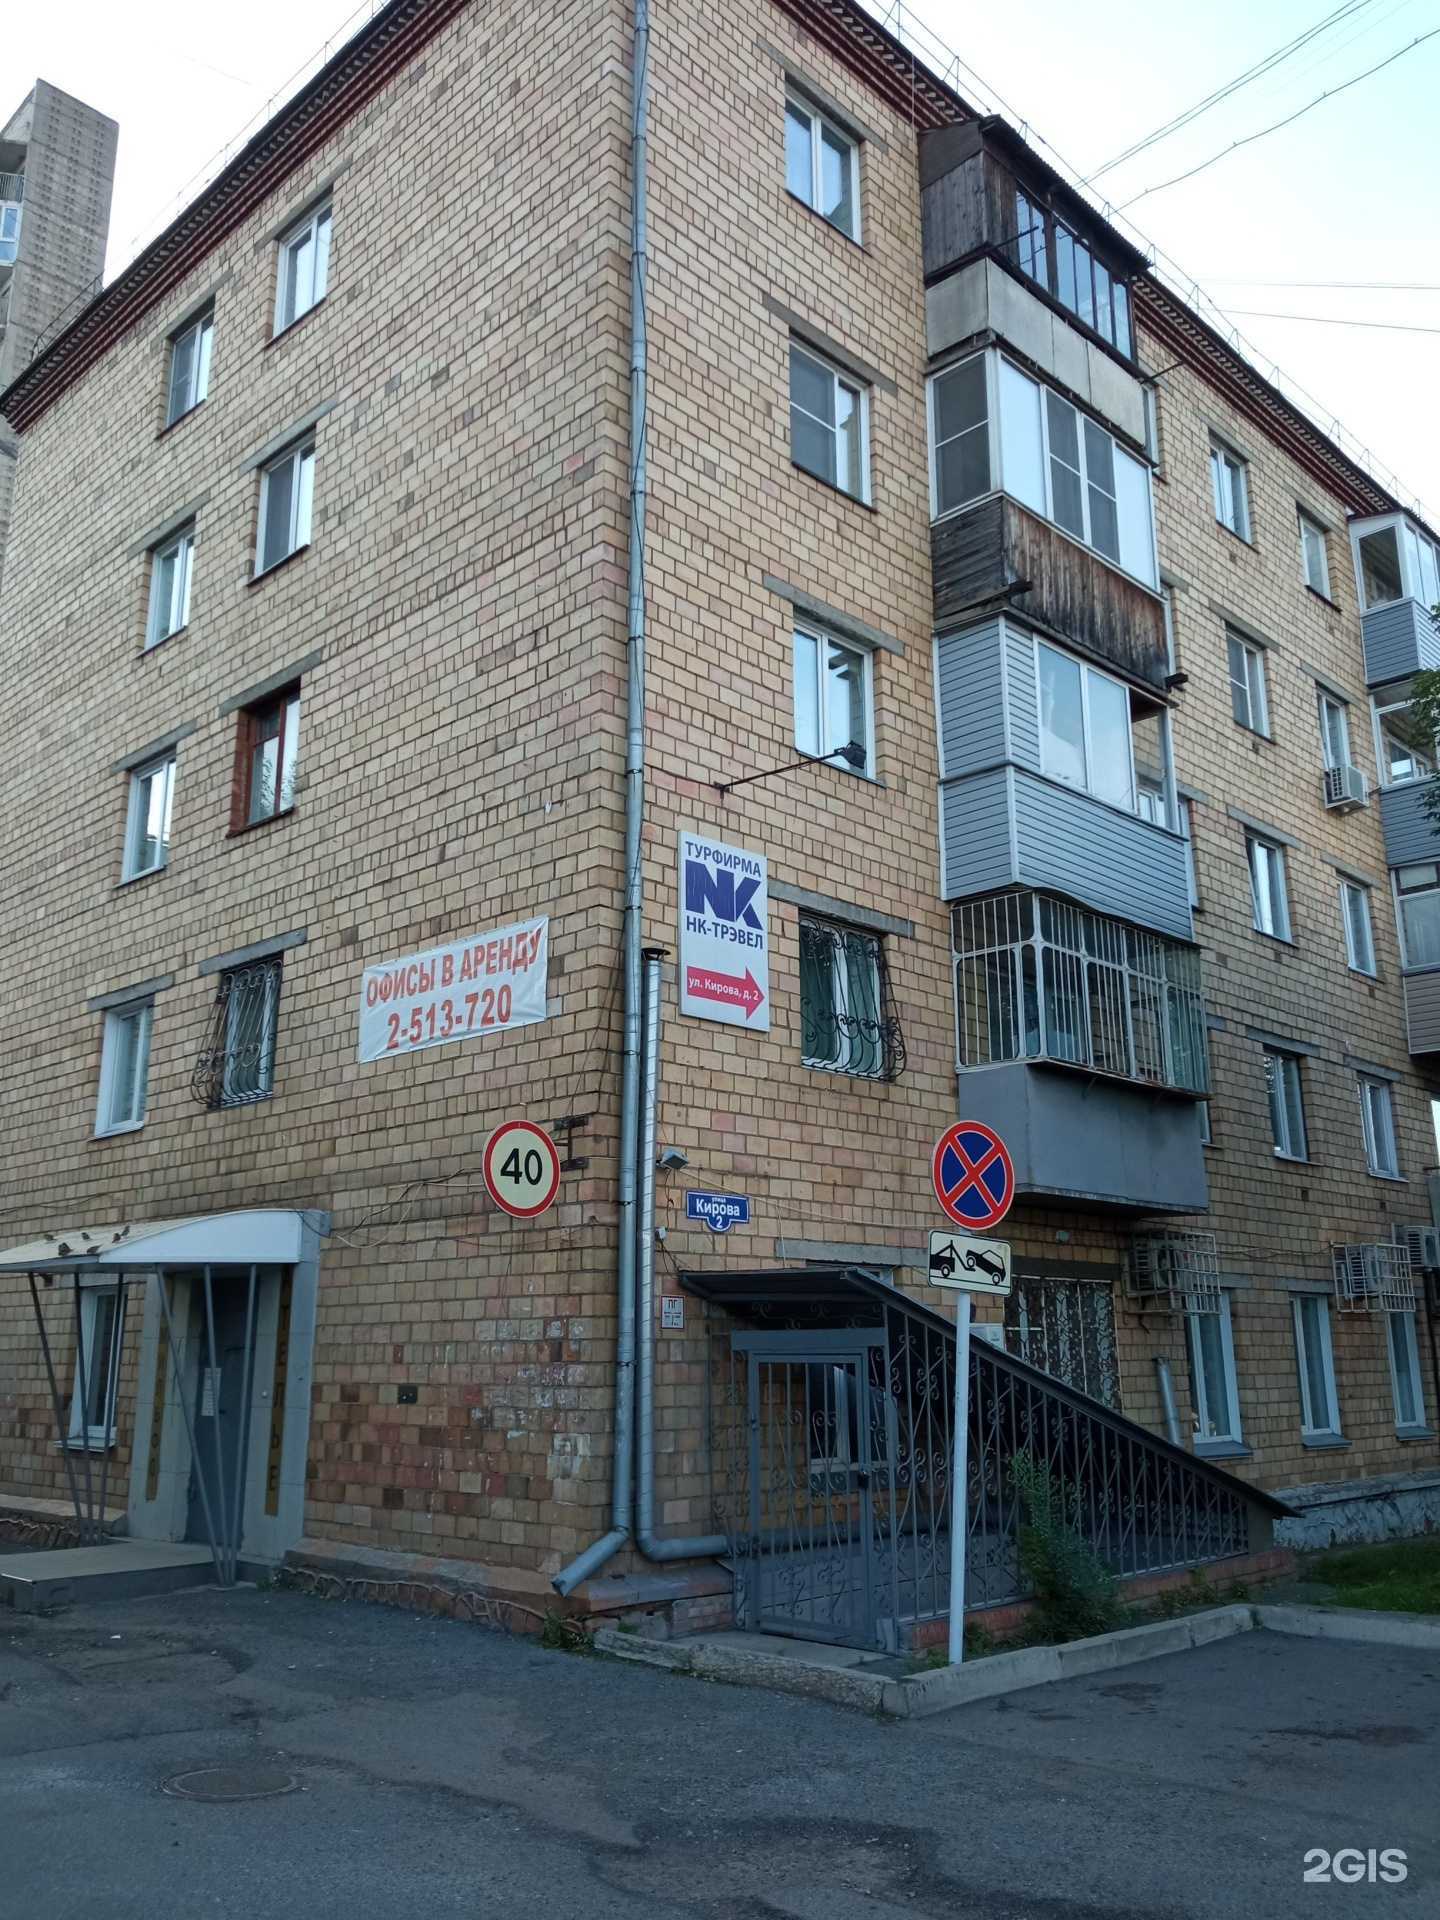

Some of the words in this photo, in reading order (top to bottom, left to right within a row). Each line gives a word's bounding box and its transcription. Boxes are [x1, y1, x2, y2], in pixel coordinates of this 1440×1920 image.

[685, 840, 762, 877] ТУРФИРМА
[686, 915, 763, 950] НК-ТРЭВЕЛ
[366, 958, 436, 1008] ОФИСЫ
[440, 953, 454, 988] В
[458, 927, 542, 983] АРЕНДУ
[688, 975, 703, 989] ул.
[704, 978, 742, 998] Кирова,
[743, 990, 752, 1001] д.
[752, 989, 759, 1001] 2
[386, 984, 512, 1050] 2-513-720
[500, 1147, 543, 1186] 40
[696, 1198, 740, 1217] Кирова
[715, 1215, 723, 1229] 2
